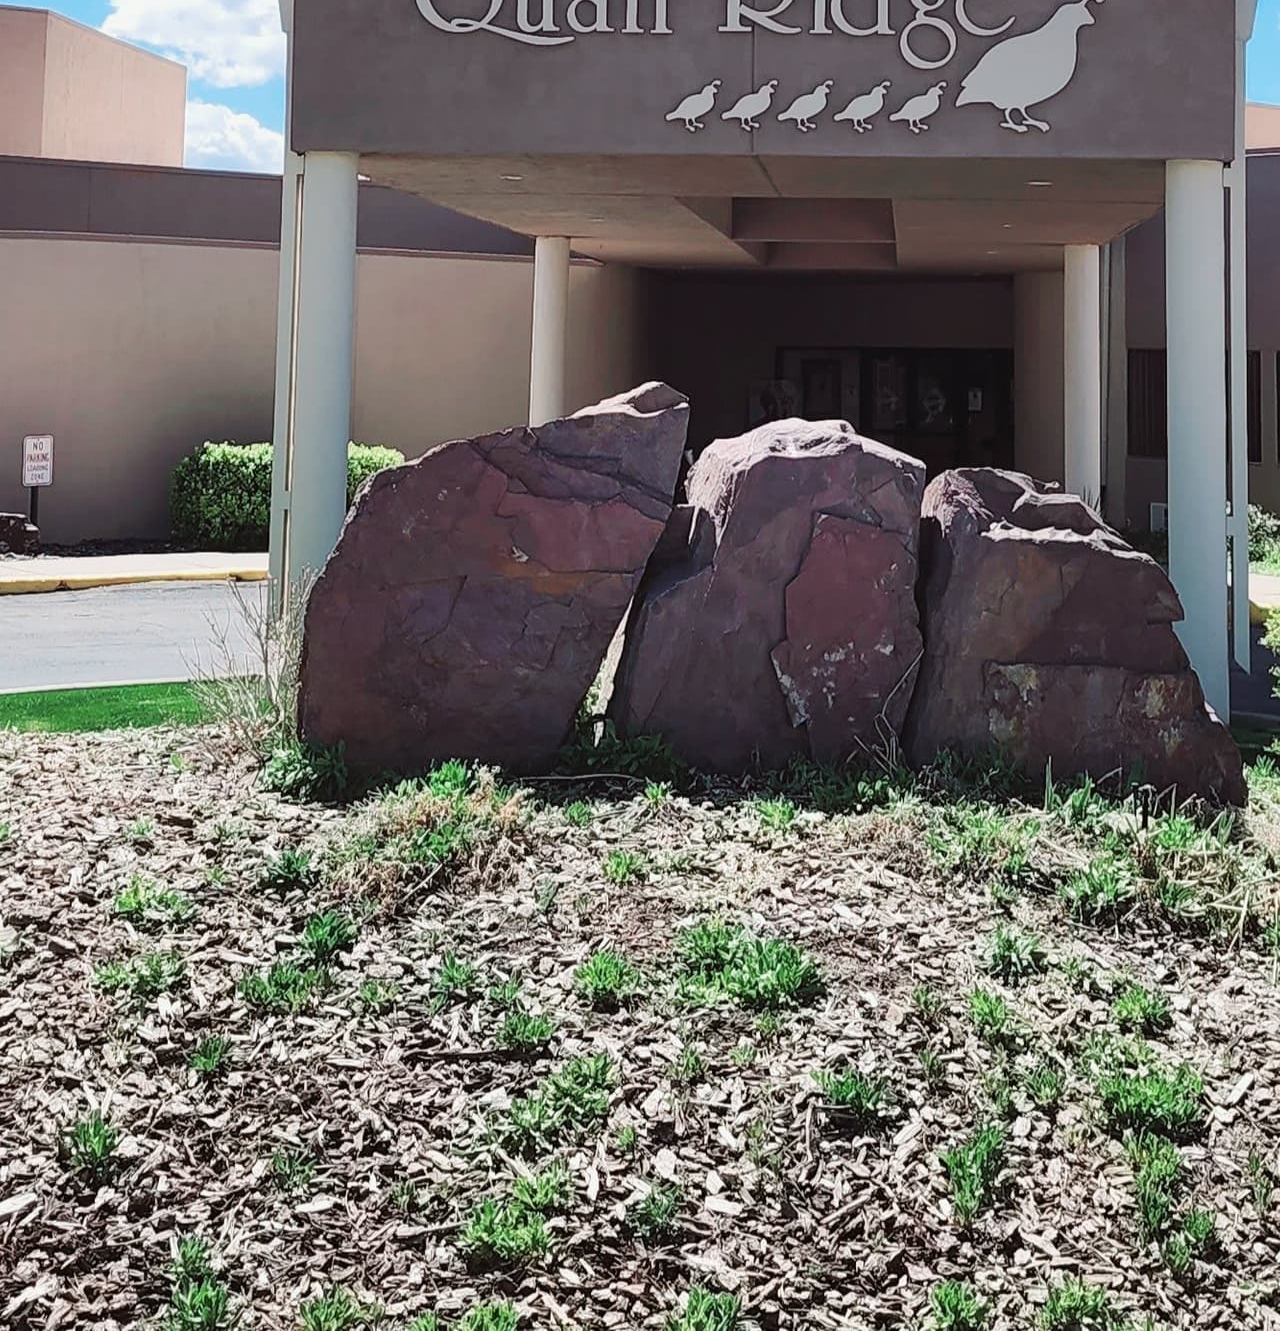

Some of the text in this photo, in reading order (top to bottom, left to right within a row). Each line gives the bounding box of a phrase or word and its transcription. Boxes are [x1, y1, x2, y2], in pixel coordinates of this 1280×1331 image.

[32, 441, 44, 451] NO
[26, 453, 49, 463] PARKING
[26, 464, 49, 472] LOADING
